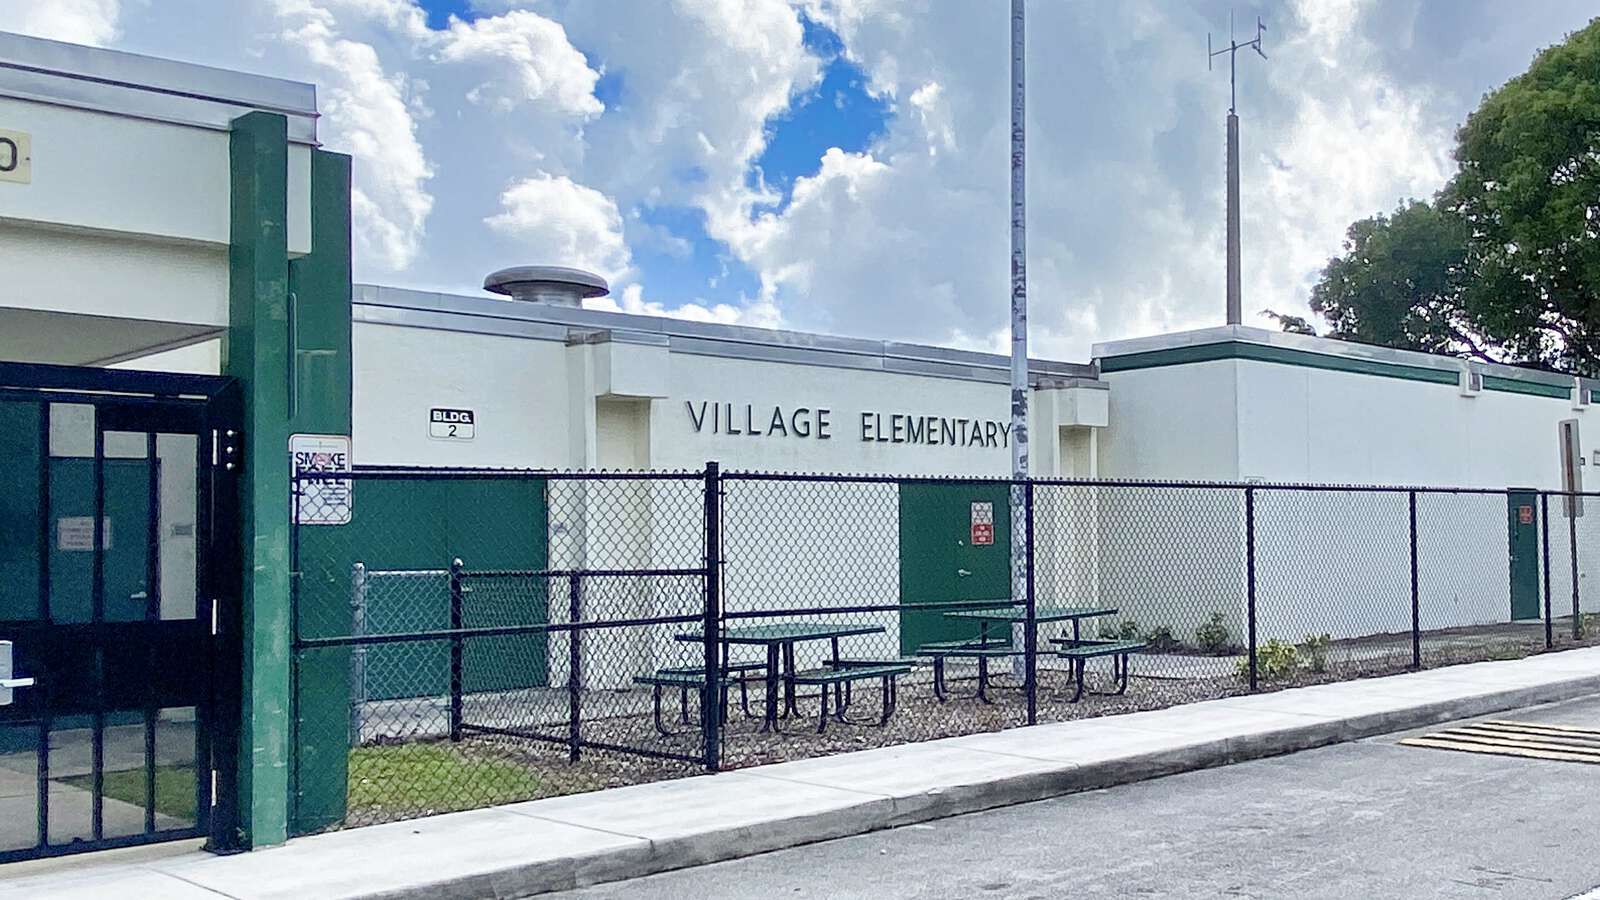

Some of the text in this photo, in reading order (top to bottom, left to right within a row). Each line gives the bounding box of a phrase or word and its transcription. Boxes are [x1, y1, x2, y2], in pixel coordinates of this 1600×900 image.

[448, 424, 457, 437] 2
[686, 400, 1012, 448] VILLAGE ELEMENTARY
